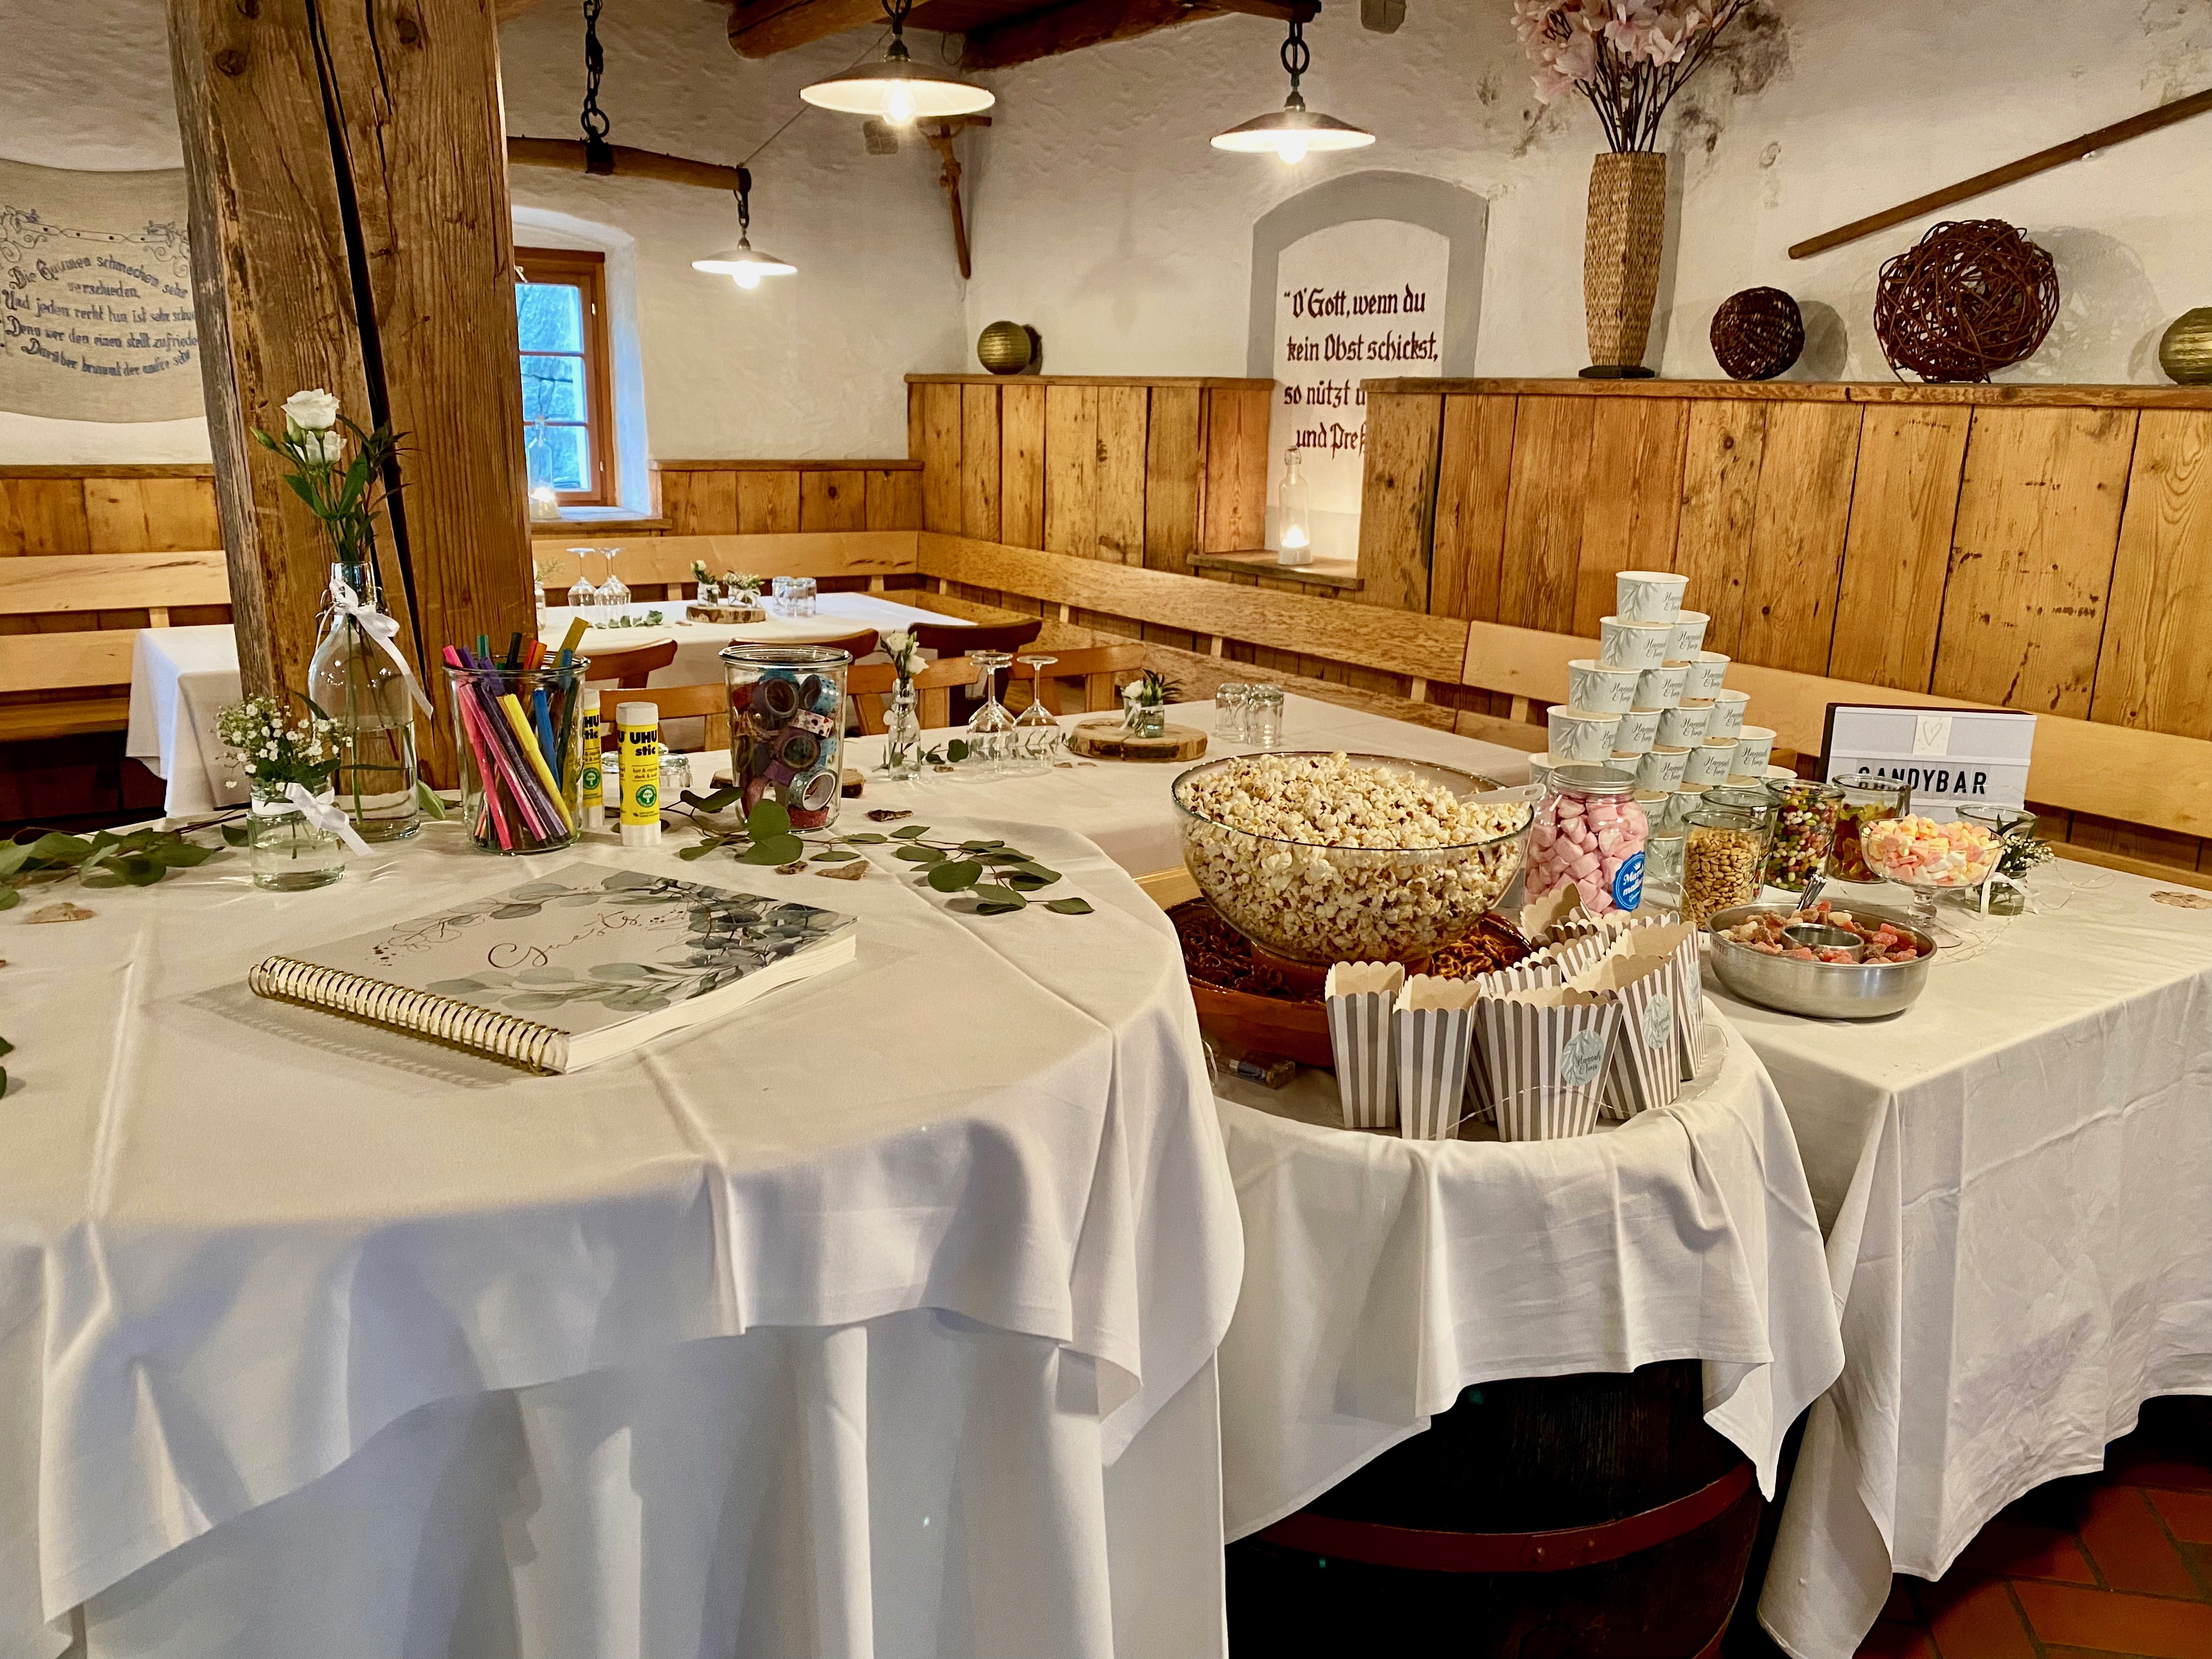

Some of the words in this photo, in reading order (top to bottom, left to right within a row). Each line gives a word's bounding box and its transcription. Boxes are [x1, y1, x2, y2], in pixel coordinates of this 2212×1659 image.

[8, 266, 36, 290] Die
[1353, 292, 1398, 315] wenn
[1402, 283, 1426, 313] du
[1286, 336, 1320, 362] kein
[1323, 333, 1364, 362] Obst
[1365, 330, 1438, 362] schickst,
[1284, 385, 1302, 405] so
[1306, 379, 1351, 408] nützt
[1355, 387, 1365, 405] u
[1296, 421, 1327, 449] und
[584, 714, 600, 728] HU
[584, 728, 599, 740] tic
[629, 730, 657, 744] UHU
[635, 744, 656, 756] stic
